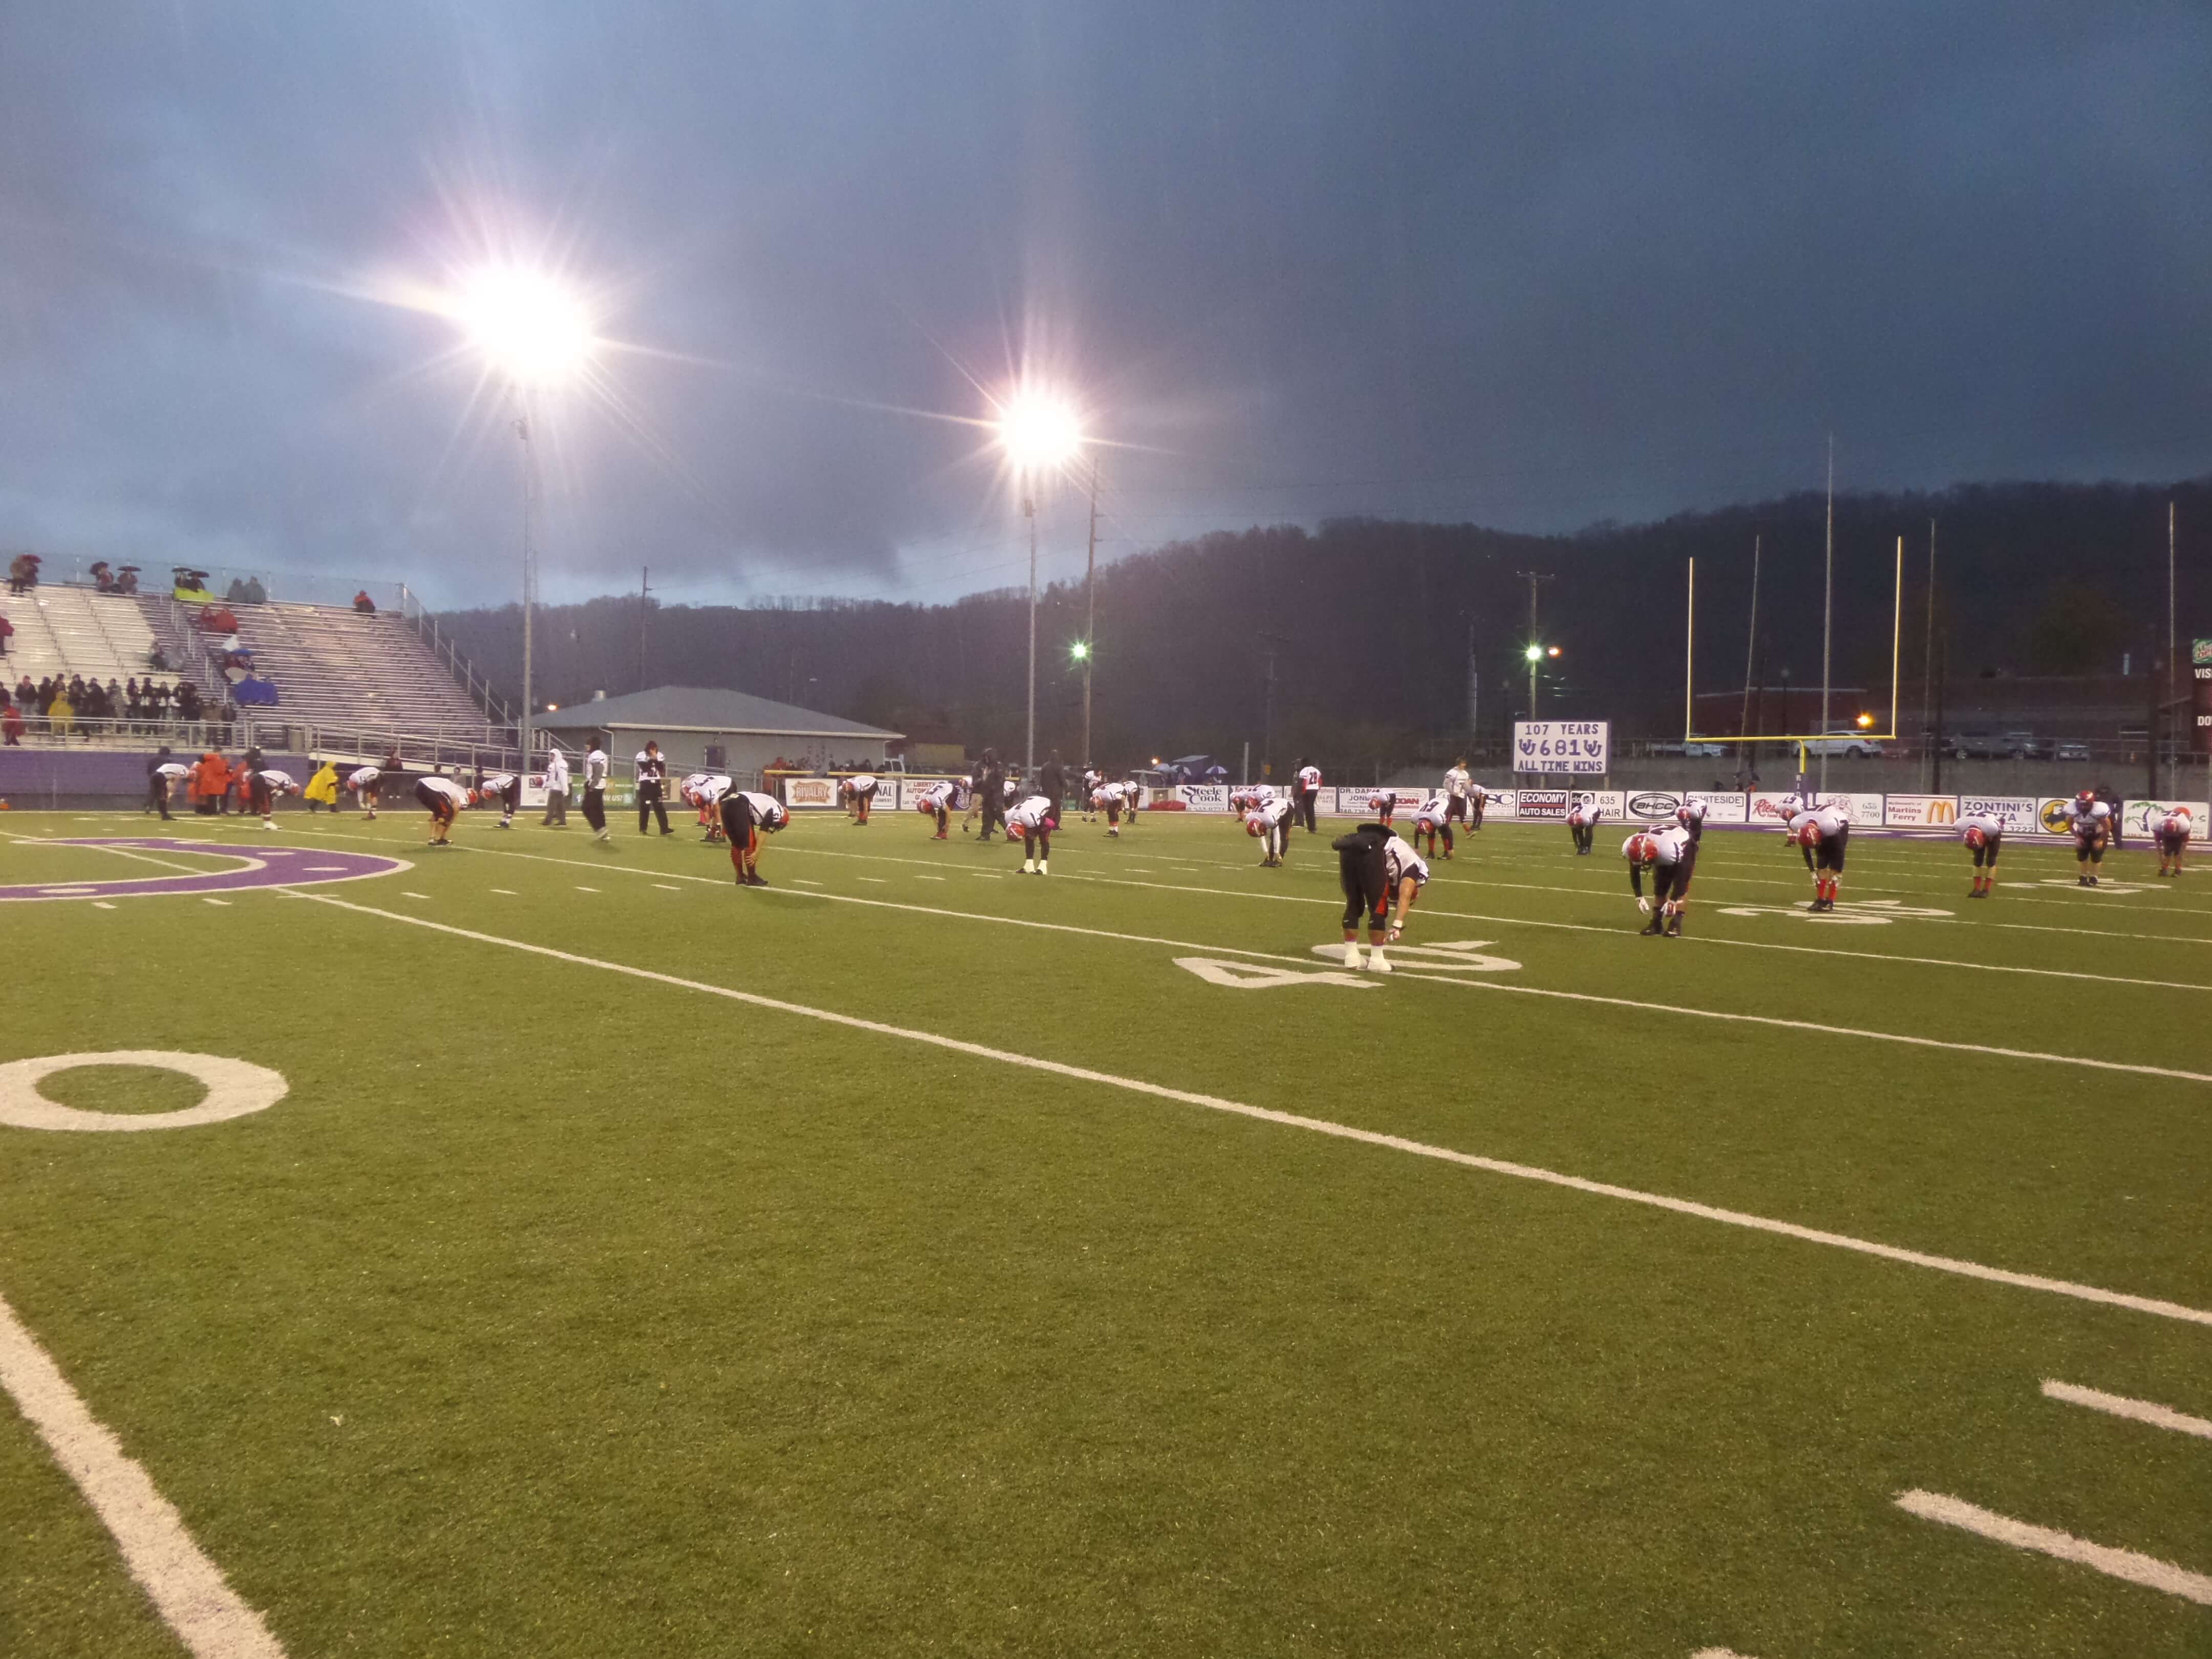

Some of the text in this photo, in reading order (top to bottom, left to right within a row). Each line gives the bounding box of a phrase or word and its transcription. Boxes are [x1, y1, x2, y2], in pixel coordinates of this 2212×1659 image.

[1525, 724, 1599, 735] 107 YEARS
[1540, 739, 1581, 756] 681
[1518, 760, 1603, 772] ALL TIME WINS
[796, 786, 827, 797] RIVALRY
[1181, 786, 1222, 796] Steele
[1189, 794, 1222, 804] Cook
[1520, 794, 1565, 803] ECONOMY
[1600, 796, 1615, 804] 635
[1964, 801, 2033, 812] ZONTINI'S
[1600, 809, 1621, 817] HAIR
